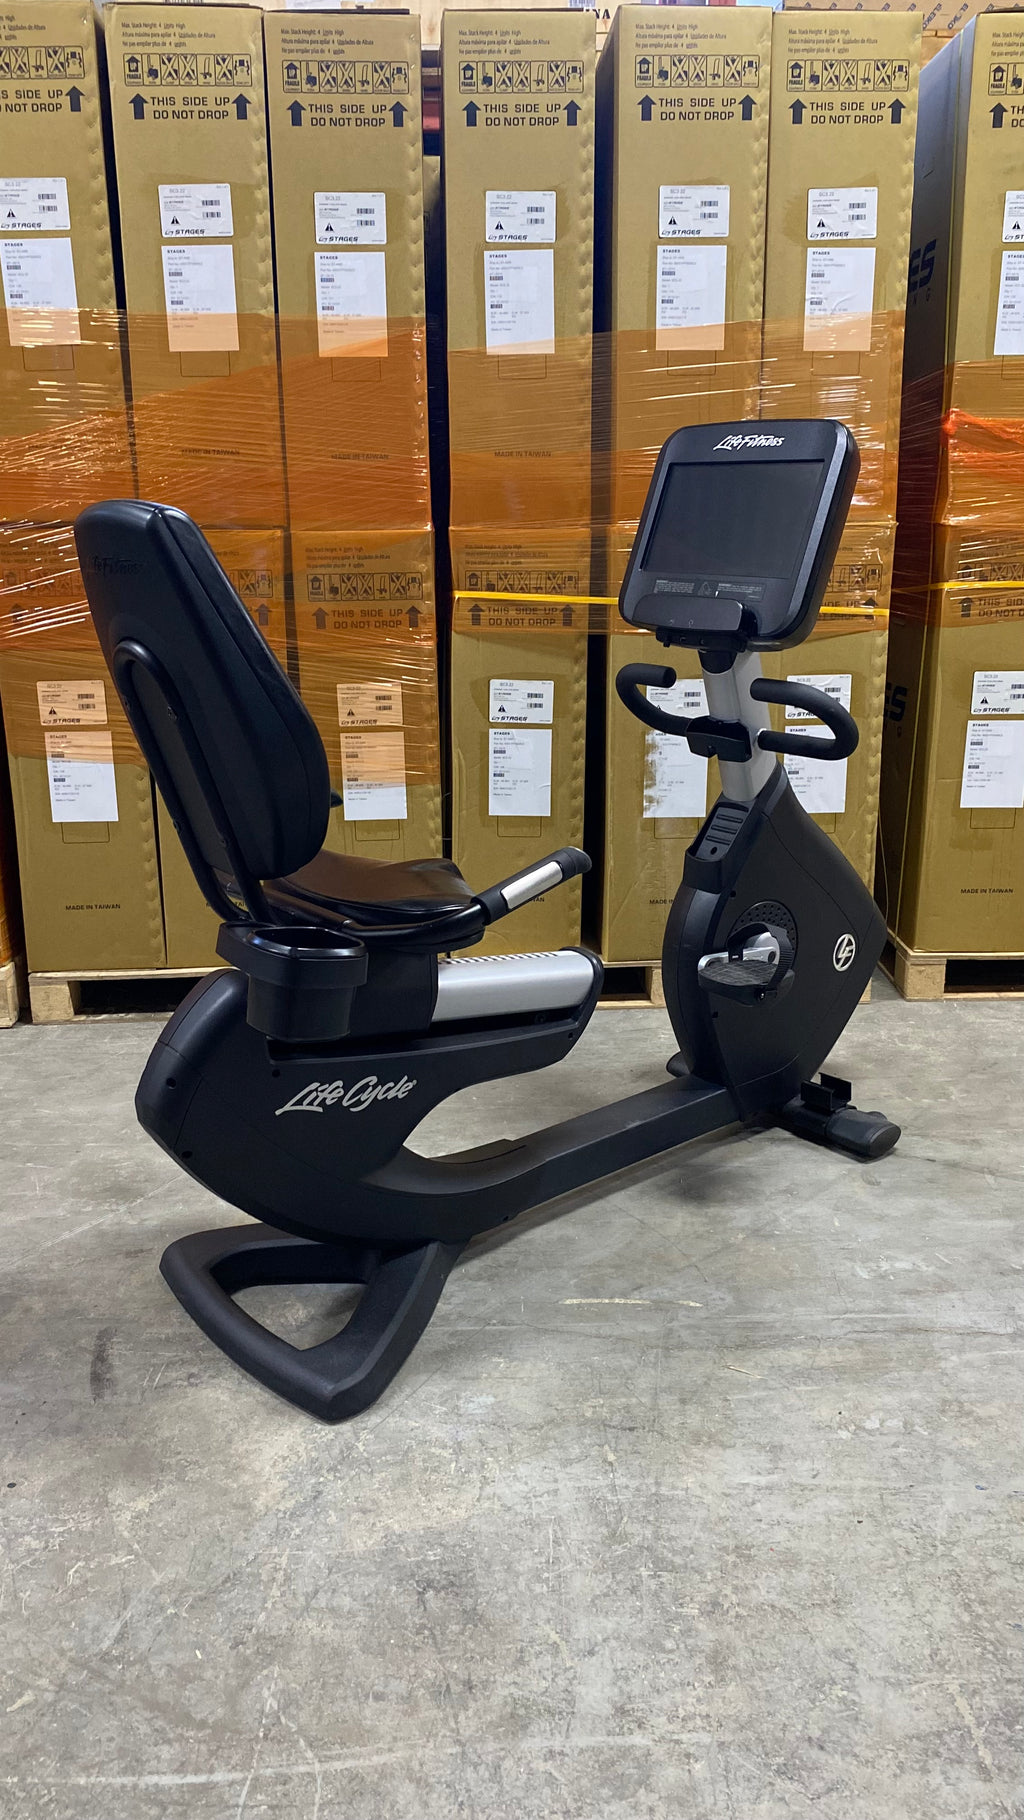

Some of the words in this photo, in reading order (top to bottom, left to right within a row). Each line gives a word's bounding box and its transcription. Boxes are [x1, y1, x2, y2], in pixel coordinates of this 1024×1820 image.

[16, 90, 40, 99] SIDE
[48, 90, 63, 99] UP
[151, 96, 176, 106] THIS
[182, 96, 208, 106] SIDE
[215, 96, 230, 106] UP
[659, 98, 683, 107] THIS
[690, 98, 714, 107] SIDE
[722, 98, 736, 107] UP
[5, 103, 28, 112] NOT
[32, 103, 62, 112] DROP
[308, 104, 333, 113] THIS
[340, 104, 365, 113] SIDE
[372, 104, 387, 113] UP
[484, 104, 508, 113] THIS
[515, 104, 539, 113] SIDE
[546, 104, 561, 113] UP
[810, 102, 834, 111] THIS
[841, 102, 864, 111] SIDE
[872, 102, 886, 111] UP
[153, 110, 169, 120] DO
[172, 110, 195, 120] NOT
[199, 110, 229, 120] DROP
[661, 112, 675, 120] DO
[679, 112, 701, 120] NOT
[704, 112, 734, 120] DROP
[811, 115, 826, 124] DO
[829, 115, 851, 124] NOT
[854, 115, 884, 124] DROP
[311, 118, 326, 127] DO
[330, 118, 352, 127] NOT
[356, 118, 385, 127] DROP
[486, 117, 500, 126] DO
[504, 117, 526, 126] NOT
[529, 117, 559, 126] DROP
[331, 609, 354, 618] THIS
[360, 609, 383, 617] SIDE
[390, 609, 403, 617] UP
